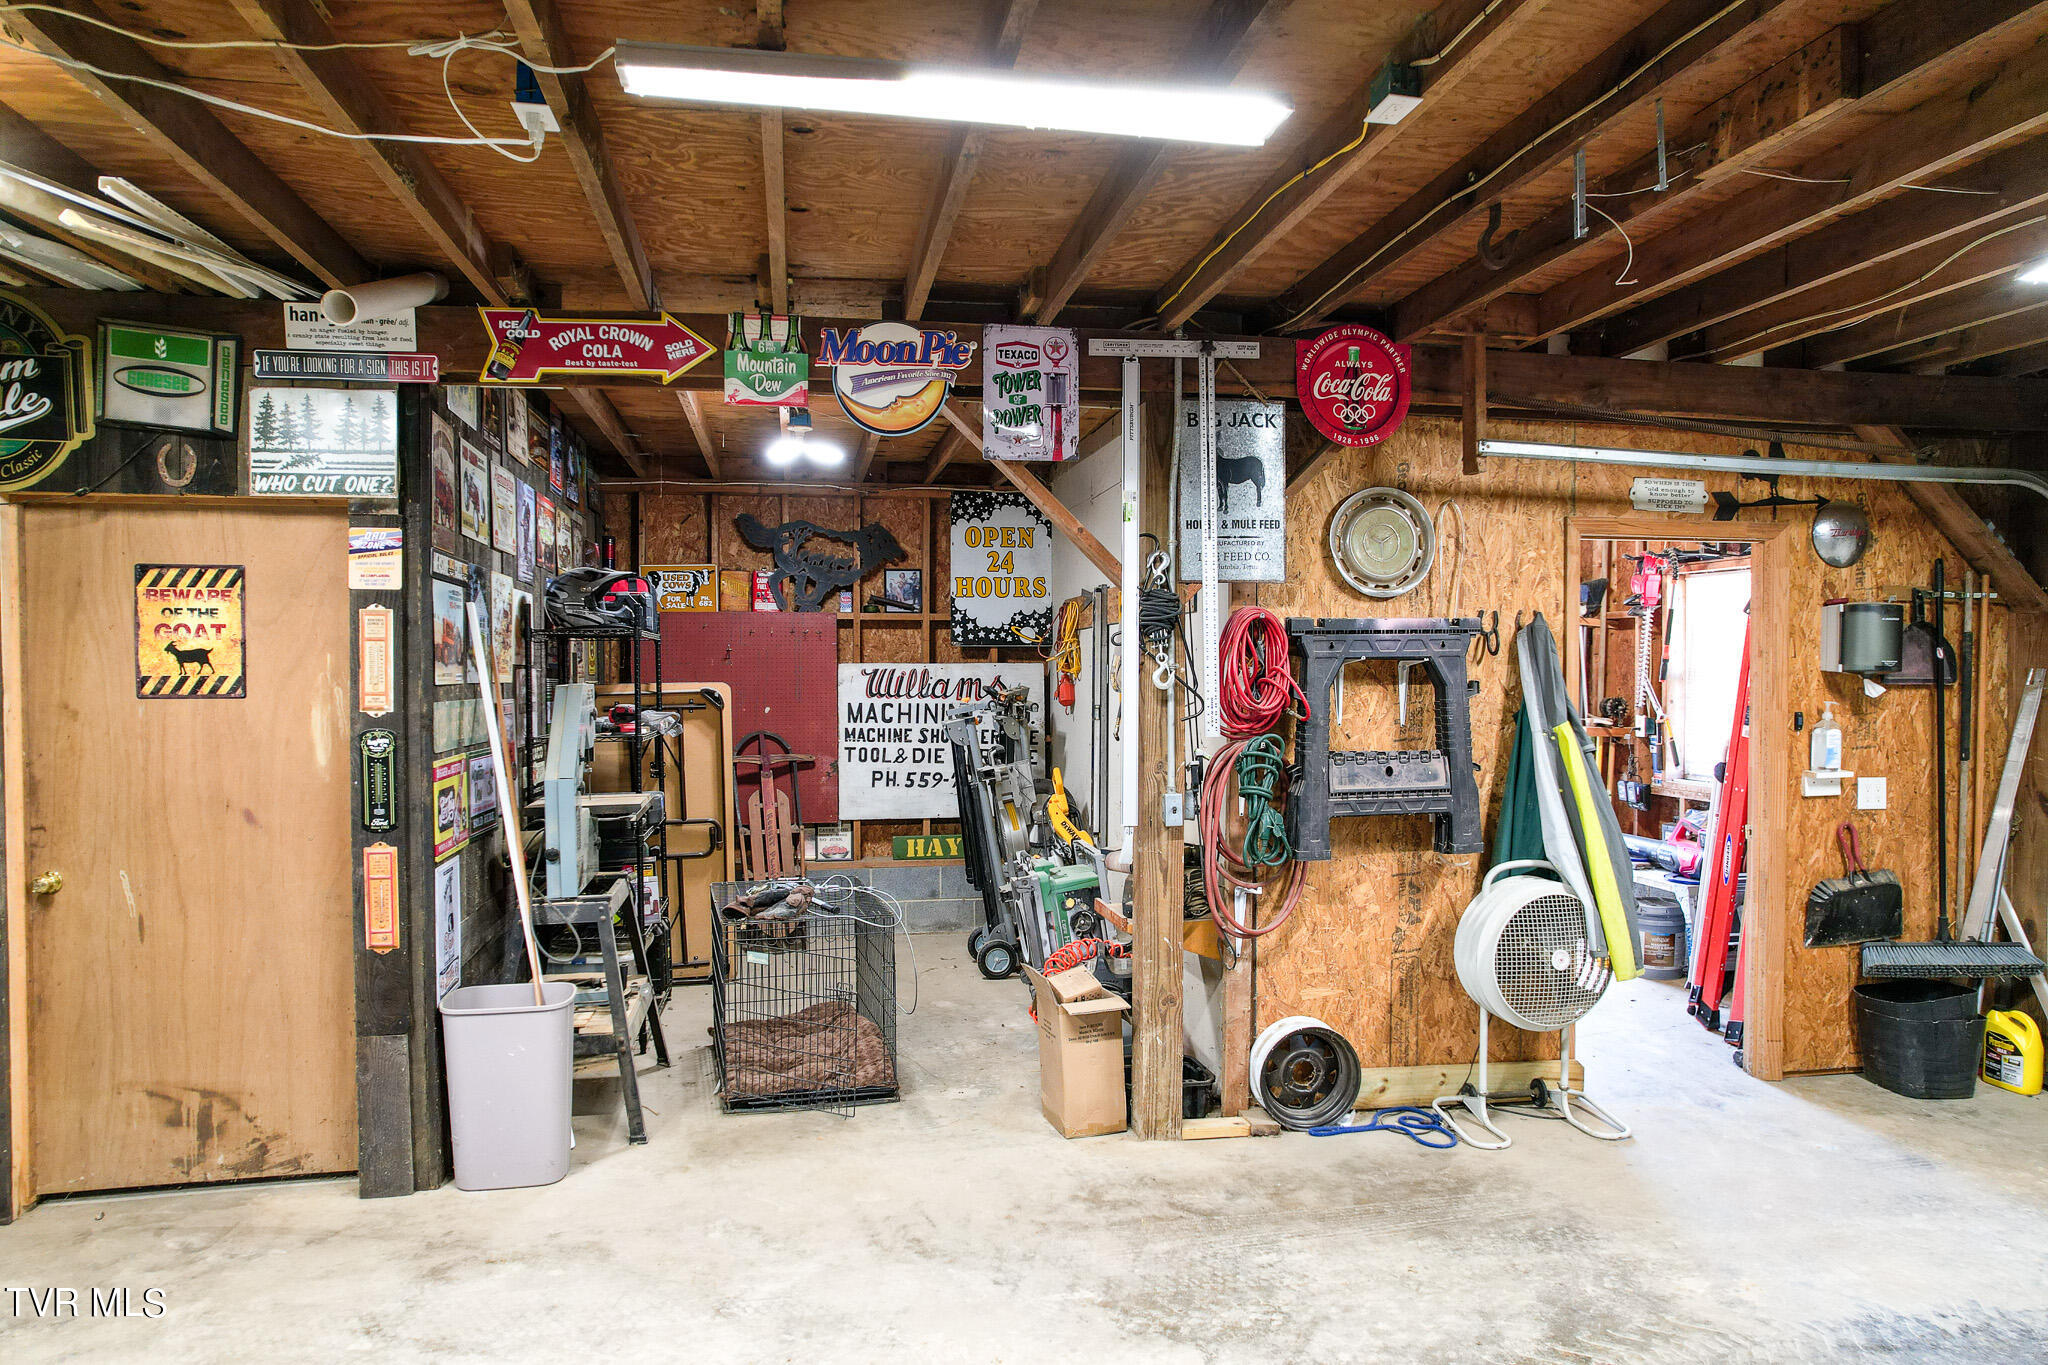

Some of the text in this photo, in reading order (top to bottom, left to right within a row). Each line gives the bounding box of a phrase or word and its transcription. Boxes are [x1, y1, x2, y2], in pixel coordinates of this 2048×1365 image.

[498, 320, 520, 329] ICE
[506, 329, 541, 338] COLD
[548, 327, 595, 352] ROYAL
[599, 325, 654, 352] CROWN
[582, 344, 623, 358] COLA
[664, 339, 694, 353] SOLD
[667, 346, 697, 360] HERE
[1301, 328, 1406, 374] WORLDWIDE OLYMPIC PARTNER
[998, 349, 1038, 360] TEXACO
[262, 354, 430, 377] IF YOU'RE LOOKING FOR A SIGN THIS IS IT
[565, 358, 584, 367] Best
[586, 359, 596, 368] by
[736, 353, 797, 375] Mountain
[1334, 360, 1374, 369] ALWAYS
[749, 373, 782, 392] Dew
[861, 374, 896, 386] American
[897, 371, 924, 380] Favorite
[924, 370, 940, 378] Since
[992, 370, 1042, 398] TOWER
[1313, 371, 1394, 402] Coca-Cola
[1013, 394, 1023, 402] OF
[990, 404, 1044, 434] POWER
[1187, 412, 1278, 429] BG JACK
[1333, 432, 1352, 444] 1928
[1359, 434, 1380, 445] 1996
[0, 449, 43, 478] Classic
[254, 475, 393, 493] WHO CUT ONE?
[1661, 487, 1686, 495] enough
[1221, 519, 1229, 529] &
[1231, 519, 1256, 530] MULE
[1260, 519, 1280, 530] FEED
[964, 526, 1036, 549] OPEN
[986, 551, 1015, 575] 24
[1224, 552, 1252, 561] FEED
[1254, 552, 1272, 561] CO.
[662, 573, 690, 582] USED
[662, 581, 692, 590] COWS
[145, 588, 233, 602] BEWARE
[954, 576, 1047, 598] HOURS
[161, 607, 219, 619] OF THE
[154, 623, 227, 641] GOAT
[844, 727, 913, 743] MACHINE
[912, 747, 945, 764] DIE
[871, 770, 900, 788] PH.
[906, 837, 963, 858] HAY
